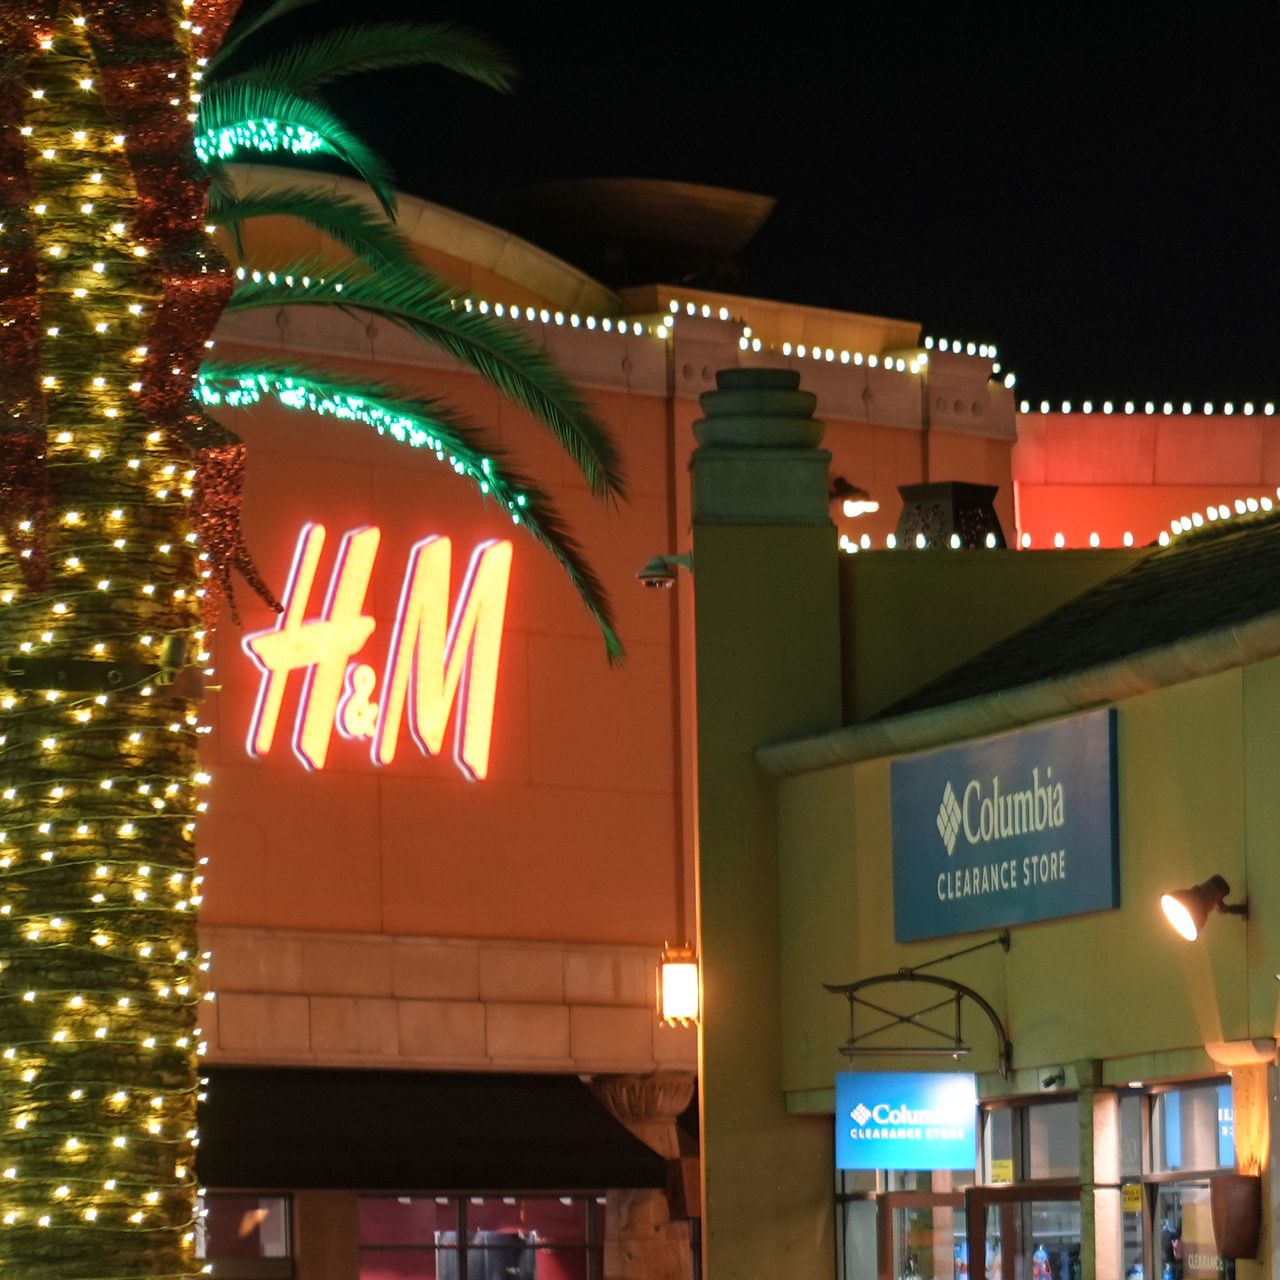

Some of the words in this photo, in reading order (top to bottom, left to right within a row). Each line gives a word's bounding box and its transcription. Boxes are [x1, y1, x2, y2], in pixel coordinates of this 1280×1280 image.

[243, 522, 512, 783] H&M
[962, 766, 1065, 844] Columbia
[937, 859, 1018, 901] CLEARANCE
[1022, 849, 1066, 887] STORE
[850, 1127, 922, 1140] CLEARANCE
